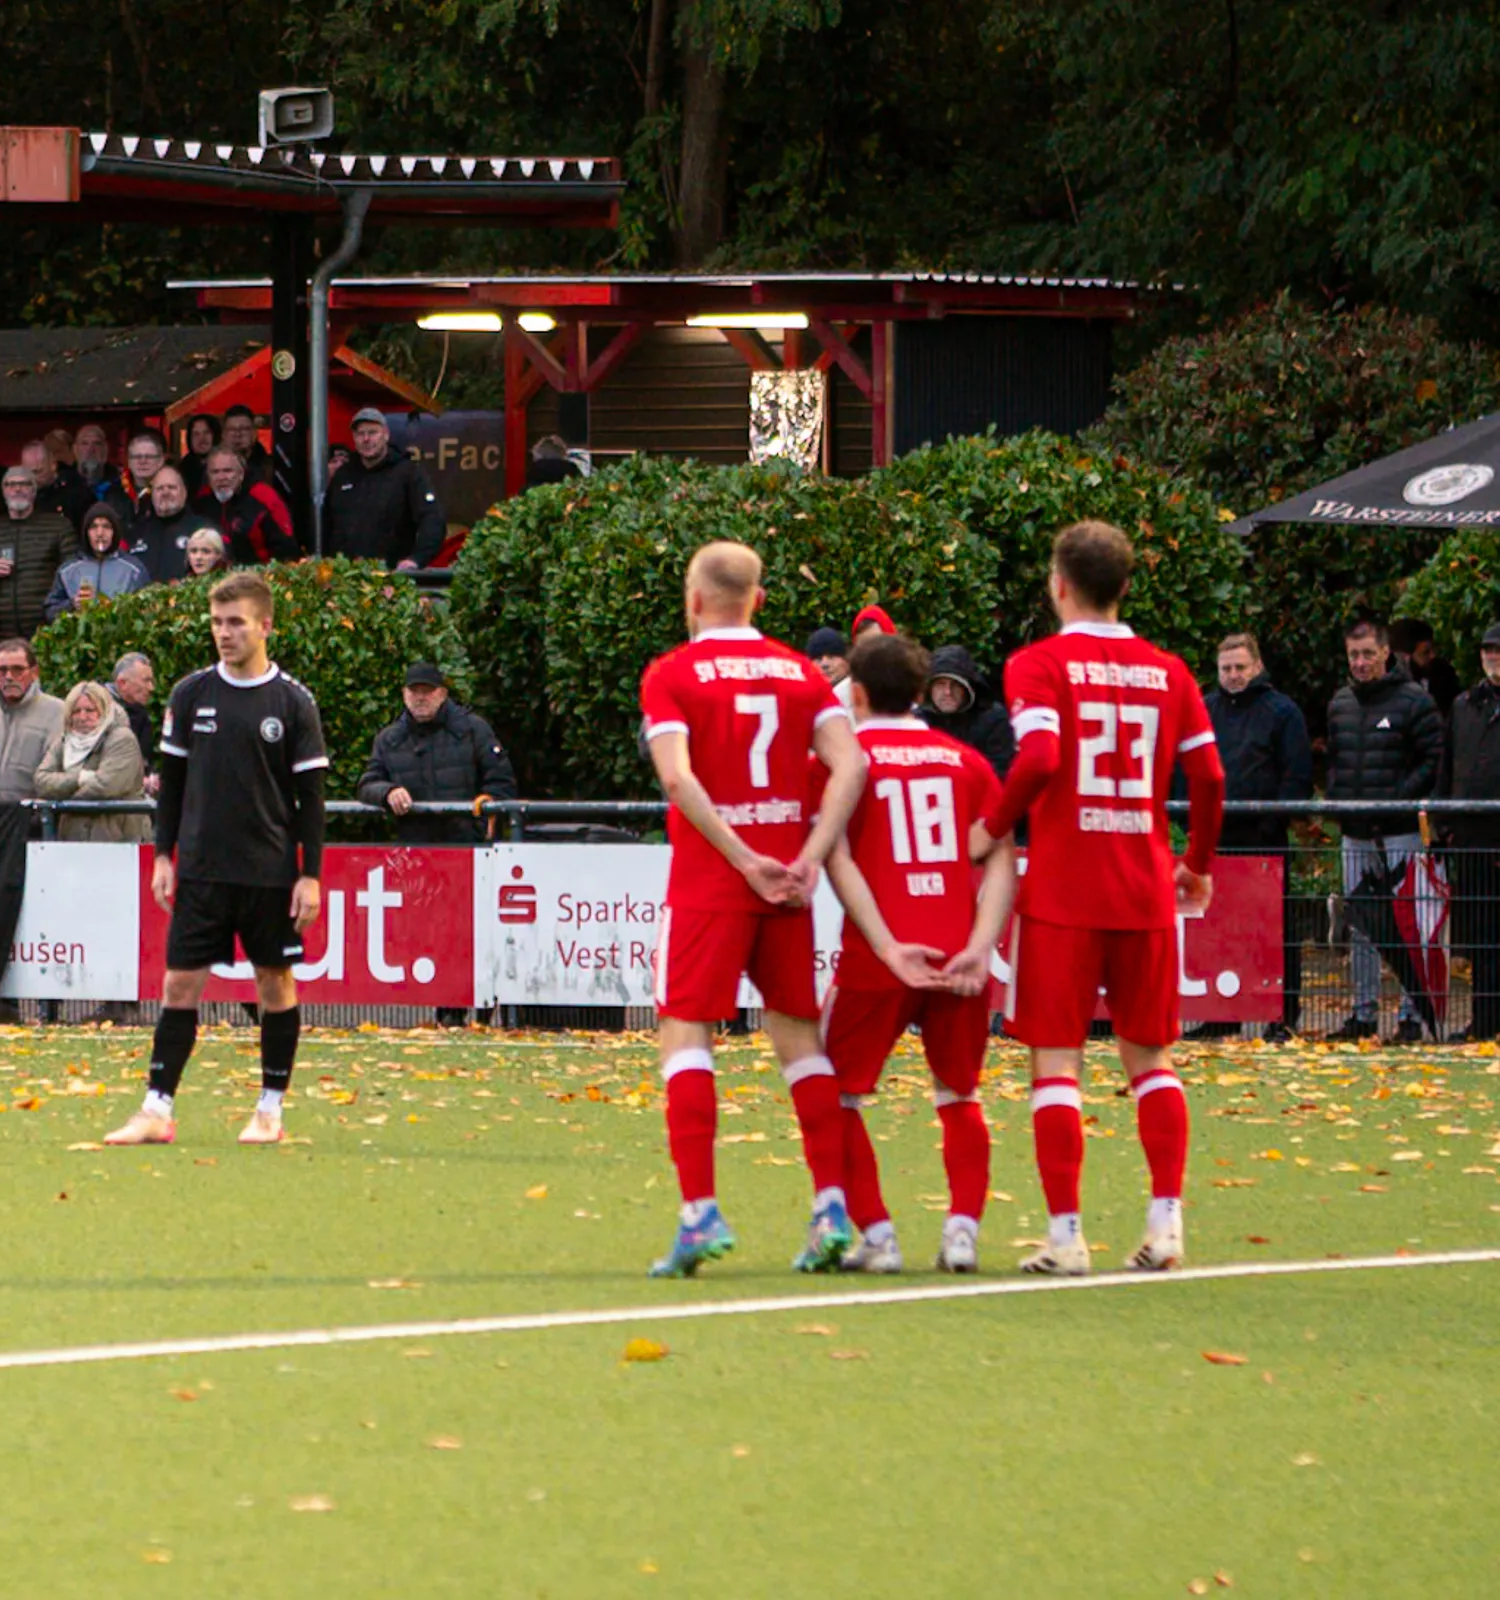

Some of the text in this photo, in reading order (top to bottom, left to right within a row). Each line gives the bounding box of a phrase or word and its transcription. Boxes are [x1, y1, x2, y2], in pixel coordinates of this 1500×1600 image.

[1309, 499, 1500, 524] WARSTEINER
[734, 693, 779, 788] 7
[1076, 701, 1159, 799] 23
[875, 776, 958, 864] 18
[557, 940, 620, 970] Vest
